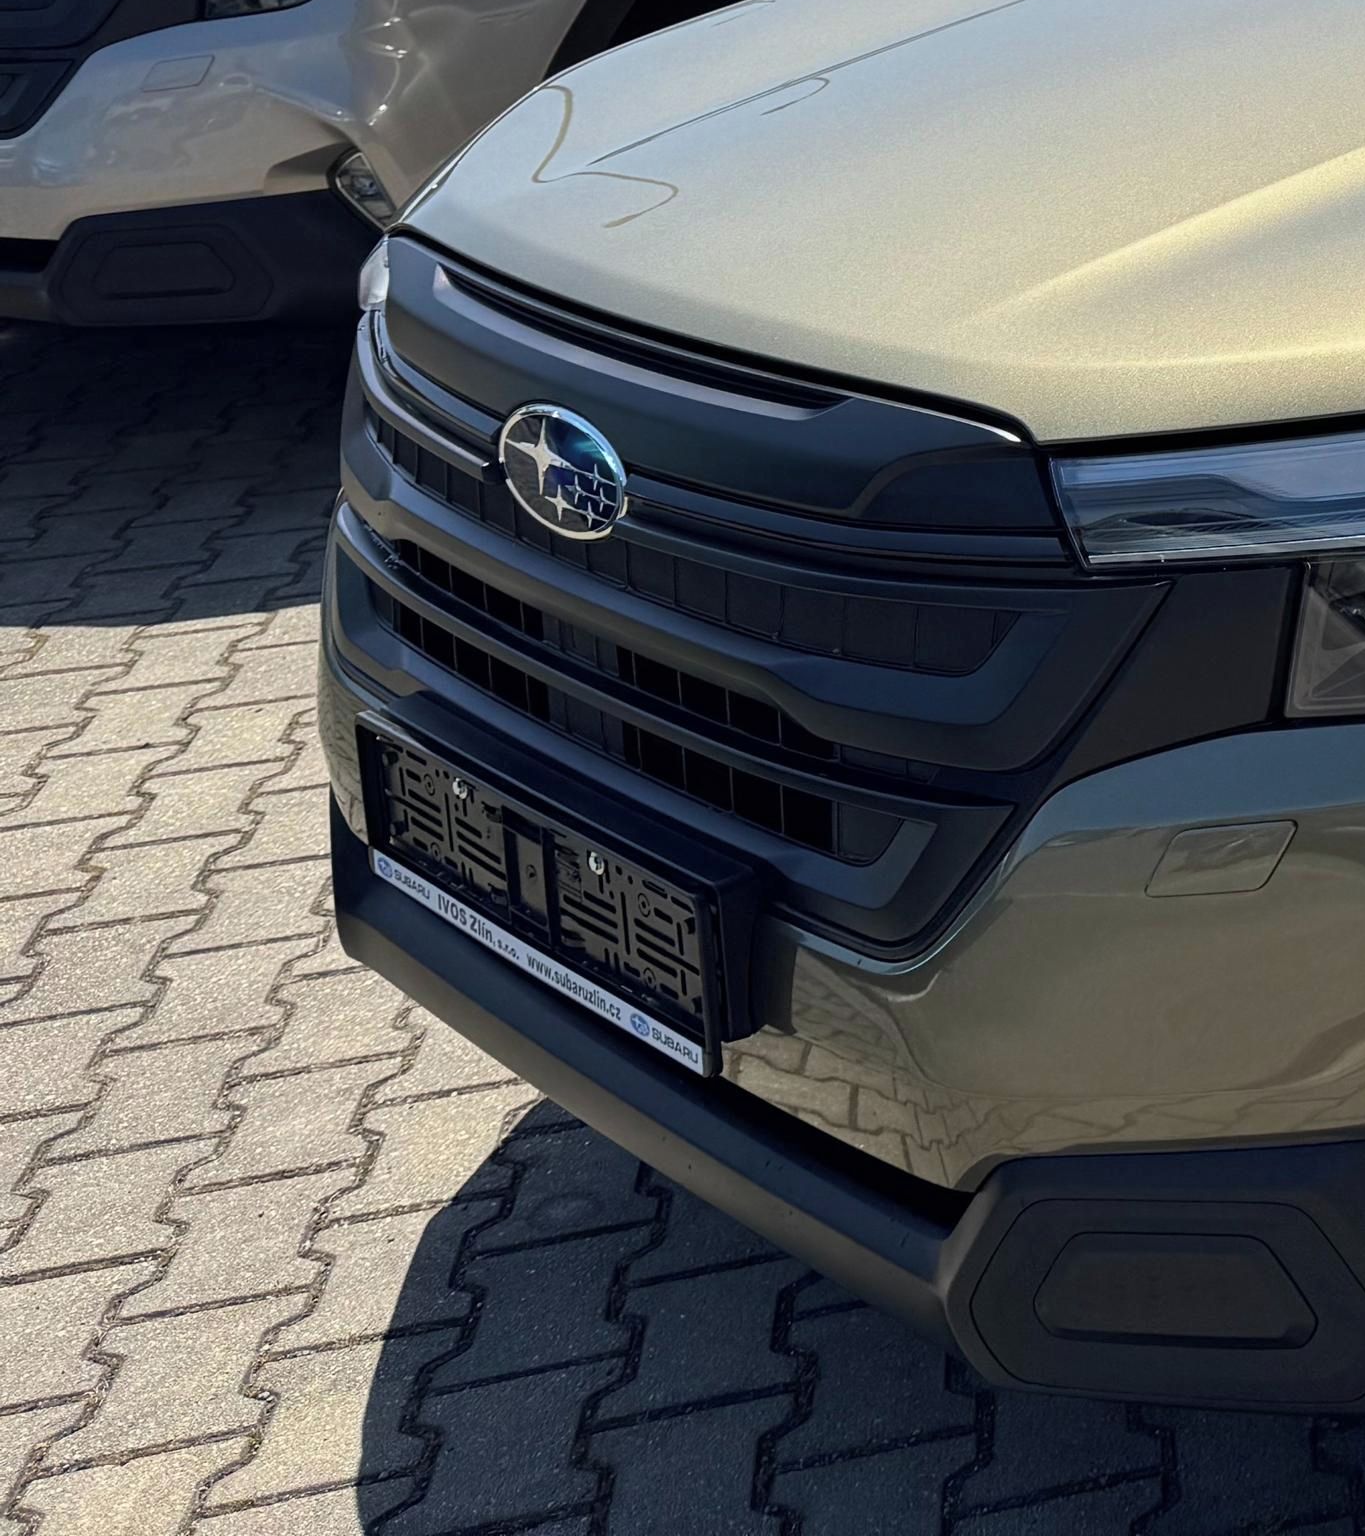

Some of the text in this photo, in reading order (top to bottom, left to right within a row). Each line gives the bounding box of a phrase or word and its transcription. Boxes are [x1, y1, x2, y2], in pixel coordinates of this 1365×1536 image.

[394, 869, 431, 900] SUBARU
[437, 893, 468, 926] IVOS
[526, 952, 622, 1021] www.subaruzlin.cz
[651, 1026, 699, 1065] SUBARU
